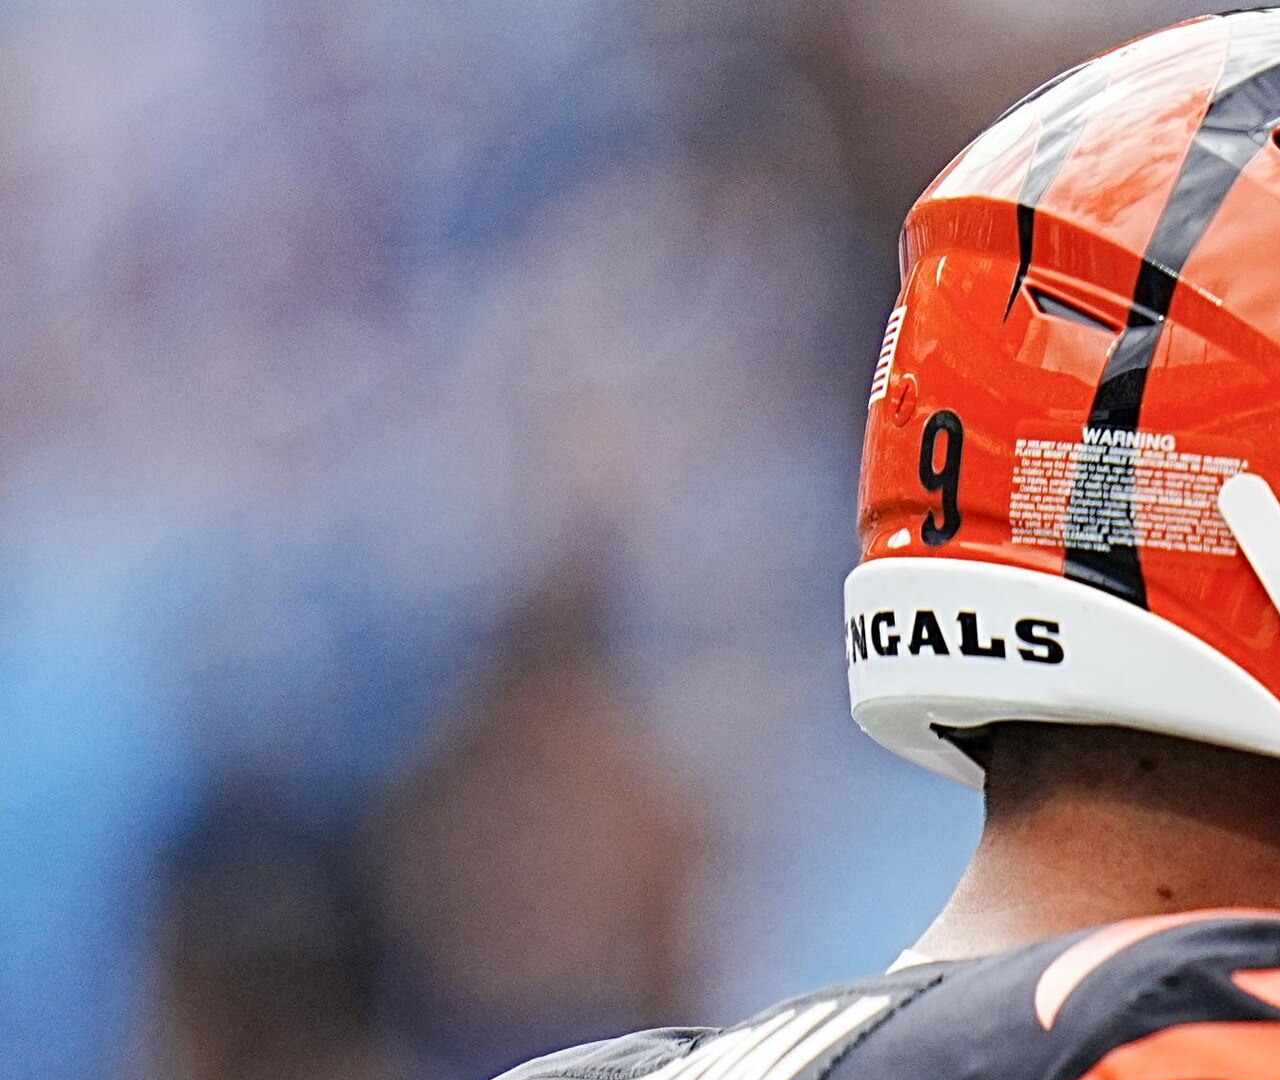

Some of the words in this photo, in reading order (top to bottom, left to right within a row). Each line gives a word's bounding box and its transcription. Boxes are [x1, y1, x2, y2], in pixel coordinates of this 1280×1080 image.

[1082, 426, 1176, 452] WARNING
[919, 410, 962, 546] 9
[846, 610, 1065, 664] NGALS
